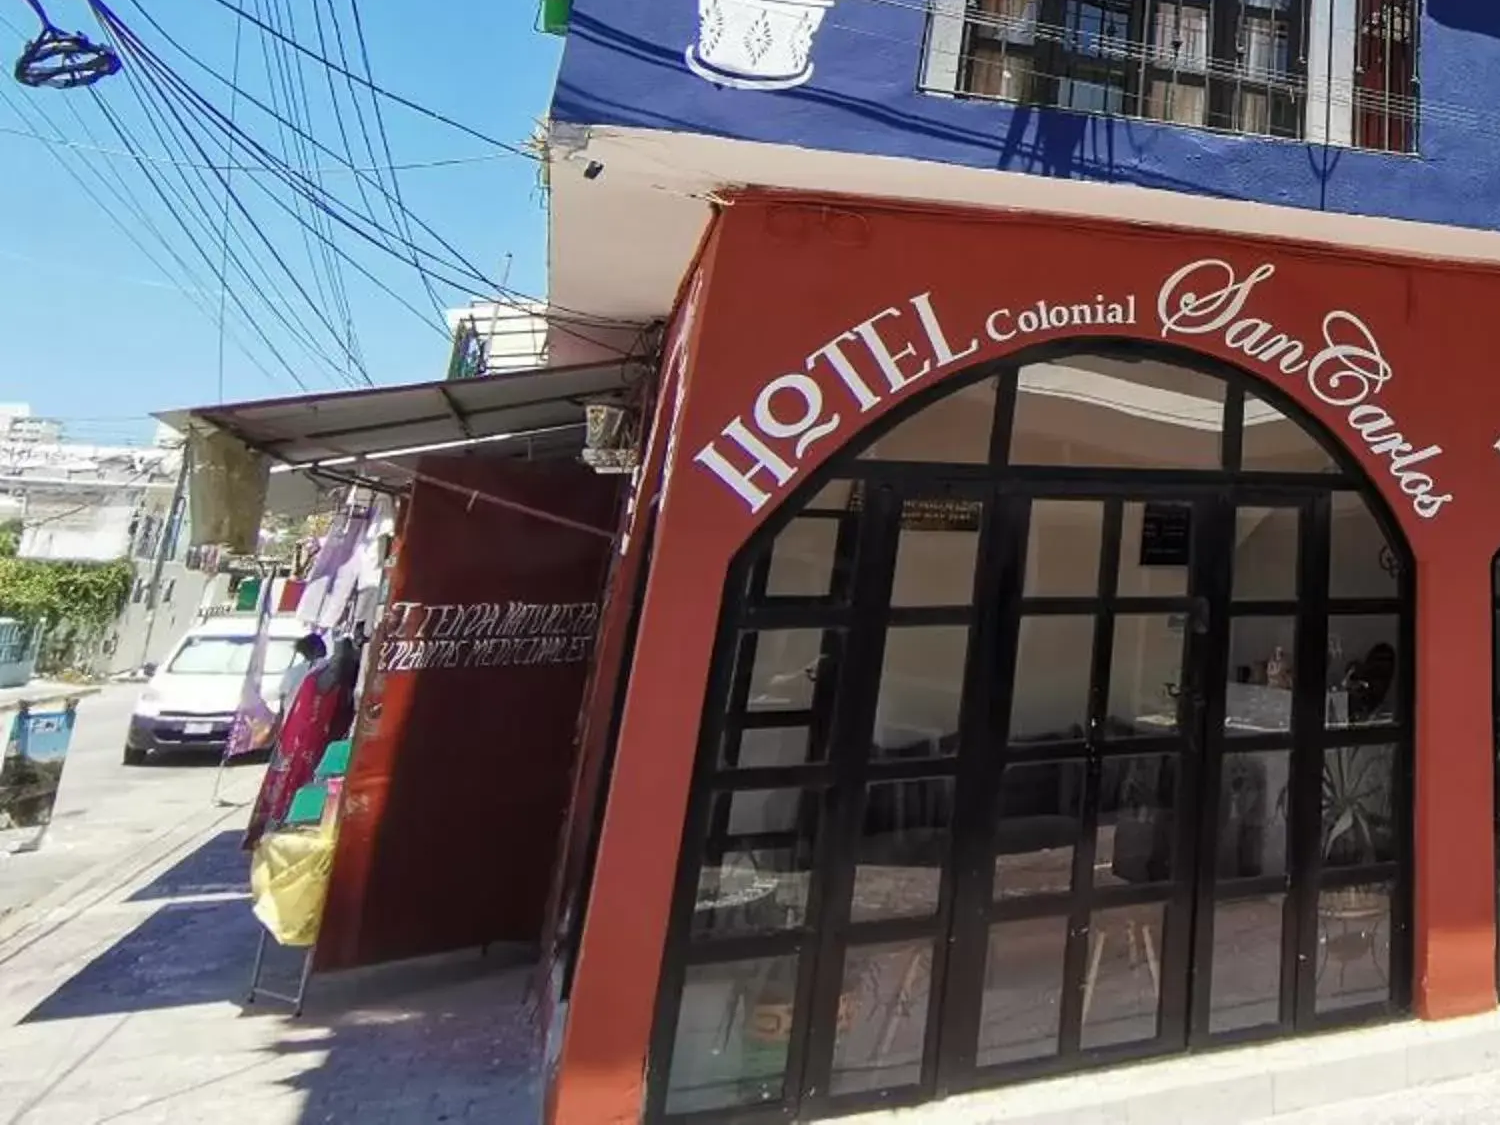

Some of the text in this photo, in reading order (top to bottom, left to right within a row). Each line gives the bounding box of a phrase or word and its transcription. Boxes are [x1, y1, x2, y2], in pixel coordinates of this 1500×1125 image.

[693, 259, 1453, 518] HOTEL Colonial San Carlos
[387, 639, 470, 671] PLANTAS
